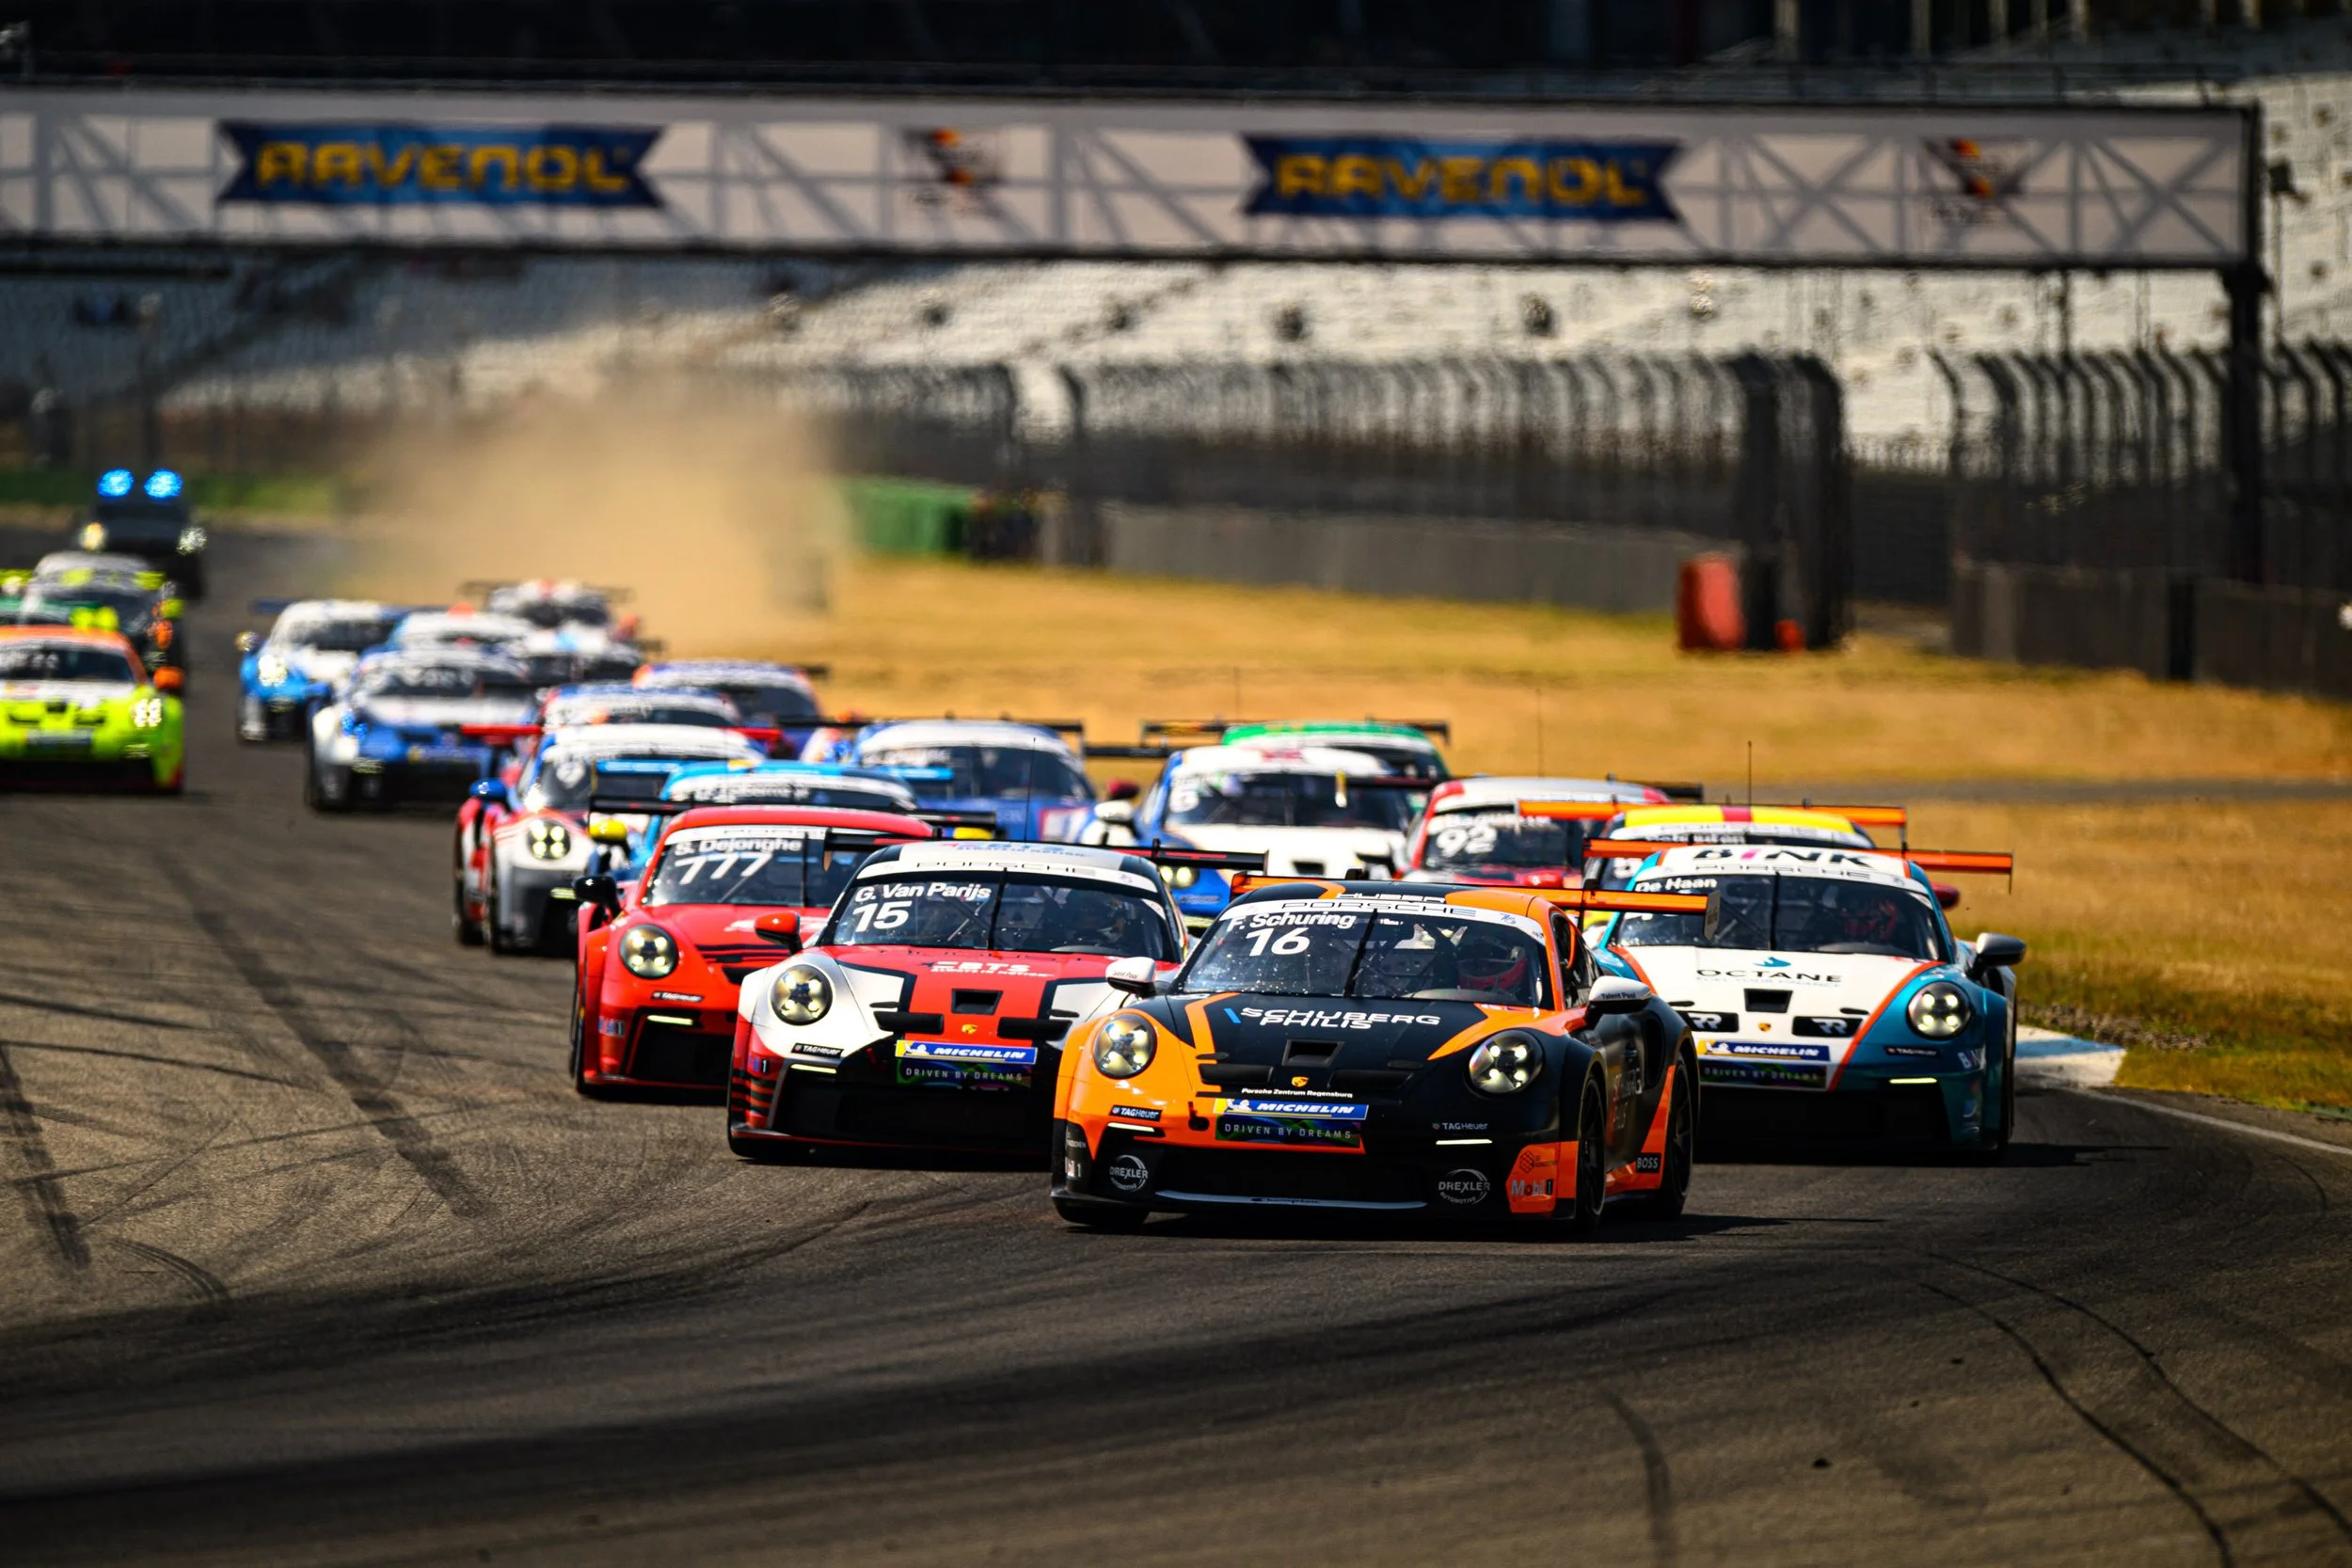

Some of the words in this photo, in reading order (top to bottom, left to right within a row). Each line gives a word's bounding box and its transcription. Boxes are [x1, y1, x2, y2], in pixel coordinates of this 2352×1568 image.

[258, 142, 628, 192] RAVENOL
[1277, 156, 1645, 206] RAVENOL
[698, 838, 803, 852] Dejonghe
[674, 851, 773, 885] 777
[854, 885, 876, 902] G.
[882, 883, 925, 898] Van
[927, 882, 992, 901] Parijs
[1635, 881, 1661, 894] De
[1665, 878, 1717, 890] Haan
[852, 900, 913, 933] 15
[1282, 901, 1476, 917] PORSCHE
[1226, 915, 1245, 932] F.
[1250, 911, 1357, 928] Schuring
[1245, 927, 1311, 957] 16
[1696, 969, 1842, 983] OCTANE
[1241, 1007, 1441, 1025] SCHUBERG
[1260, 1016, 1373, 1030] PHILIS
[934, 1047, 1026, 1059] MICHELIN
[1734, 1045, 1820, 1057] MICHELIN
[906, 1068, 948, 1078] DRIVEN
[955, 1070, 968, 1079] BY
[974, 1071, 1023, 1081] DREAMS
[1704, 1067, 1746, 1077] DRIVEN
[1307, 1090, 1353, 1099] Regensburg
[1257, 1103, 1355, 1114] MICHELIN
[1225, 1123, 1270, 1134] DRIVEN
[1278, 1127, 1293, 1136] BY
[1299, 1128, 1351, 1139] DREAMS
[1636, 1157, 1659, 1169] BOSS
[1109, 1165, 1149, 1180] DREXLER
[1438, 1180, 1490, 1194] DREXLER
[1512, 1180, 1546, 1196] Mobil
[1439, 1191, 1477, 1204] AUTOMOTIVE
